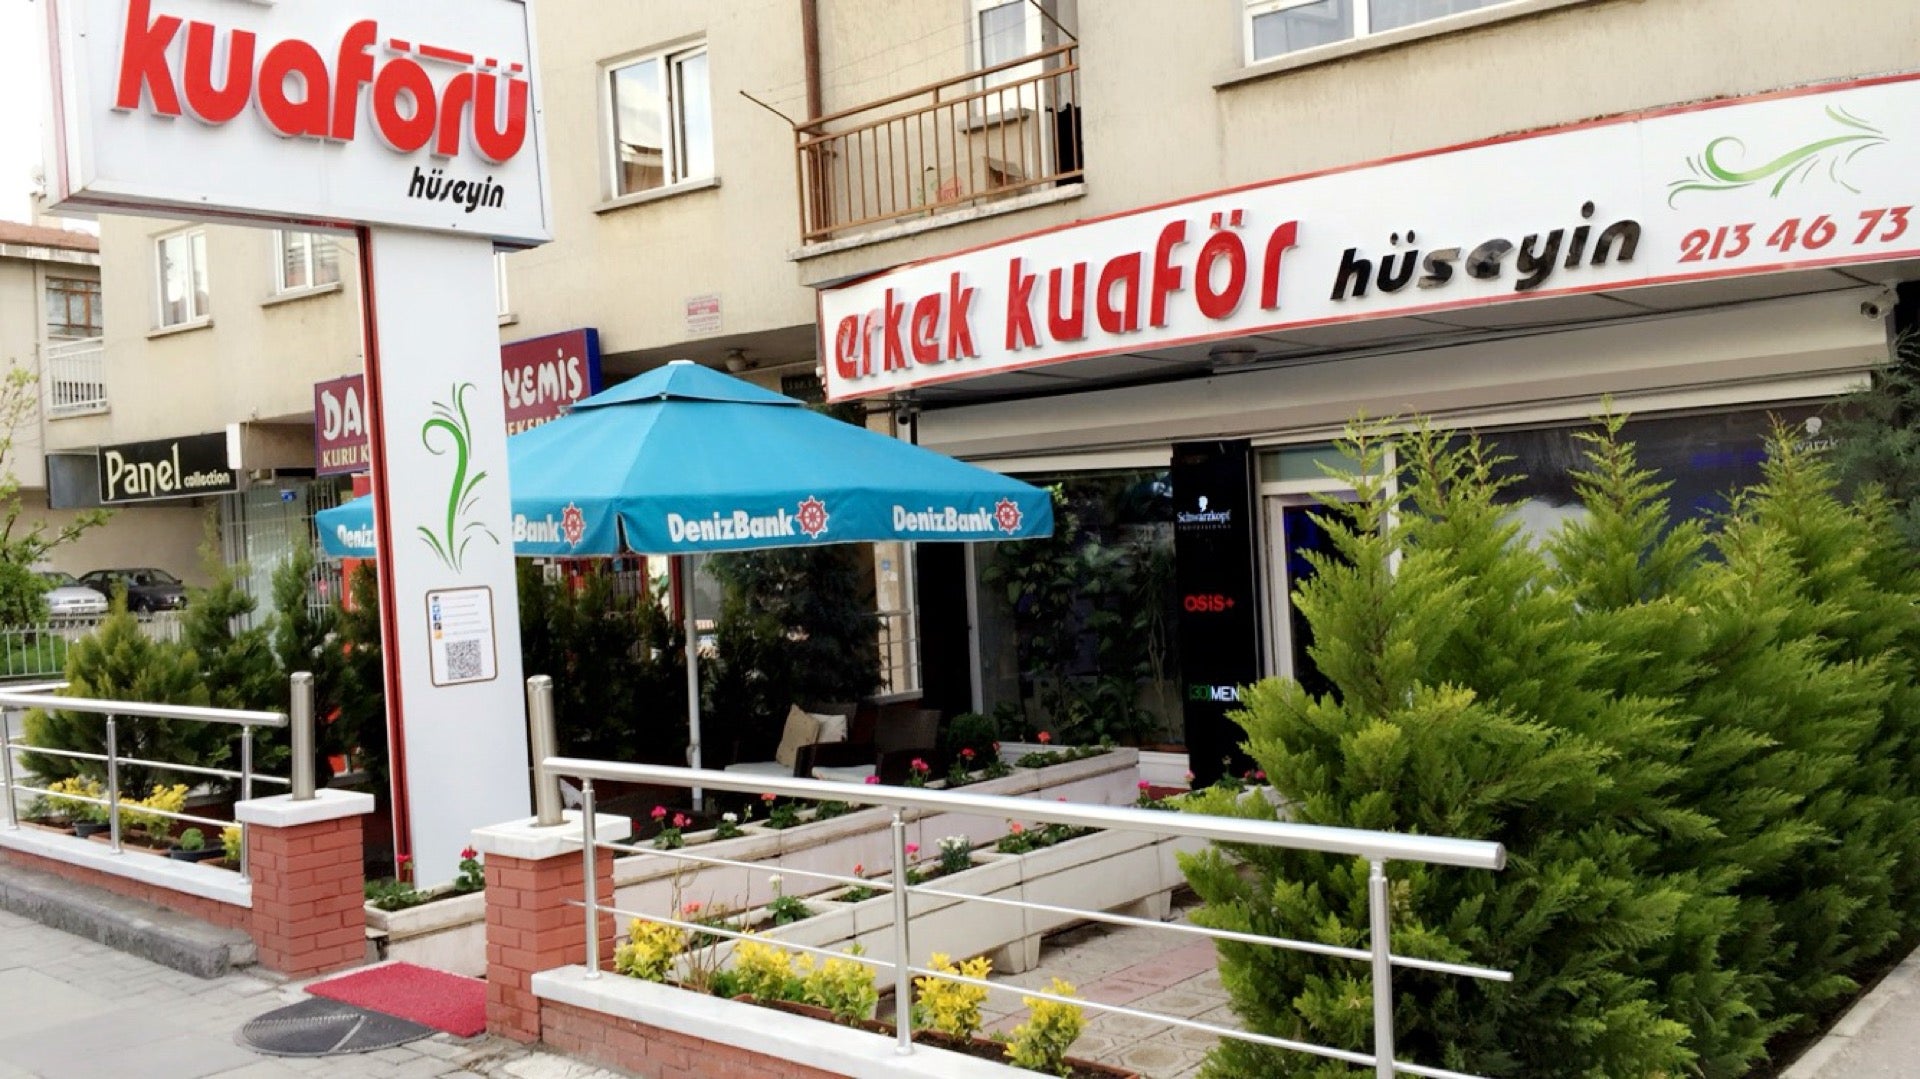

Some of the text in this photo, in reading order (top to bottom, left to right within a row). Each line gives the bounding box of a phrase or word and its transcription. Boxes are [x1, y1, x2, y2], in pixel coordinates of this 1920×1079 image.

[112, 0, 529, 163] kuaförü
[409, 166, 506, 214] hüseyin
[1677, 205, 1915, 264] 213 46 73
[835, 199, 1643, 380] erkek kuaför hüseyin
[321, 386, 368, 441] DA
[105, 442, 231, 500] Panel collection
[323, 446, 357, 468] KURU
[336, 523, 376, 549] Deniz
[511, 513, 561, 543] Bank
[667, 508, 796, 543] DenizBank
[892, 504, 995, 533] DenizBank
[1177, 509, 1231, 525] Schwarzkopf
